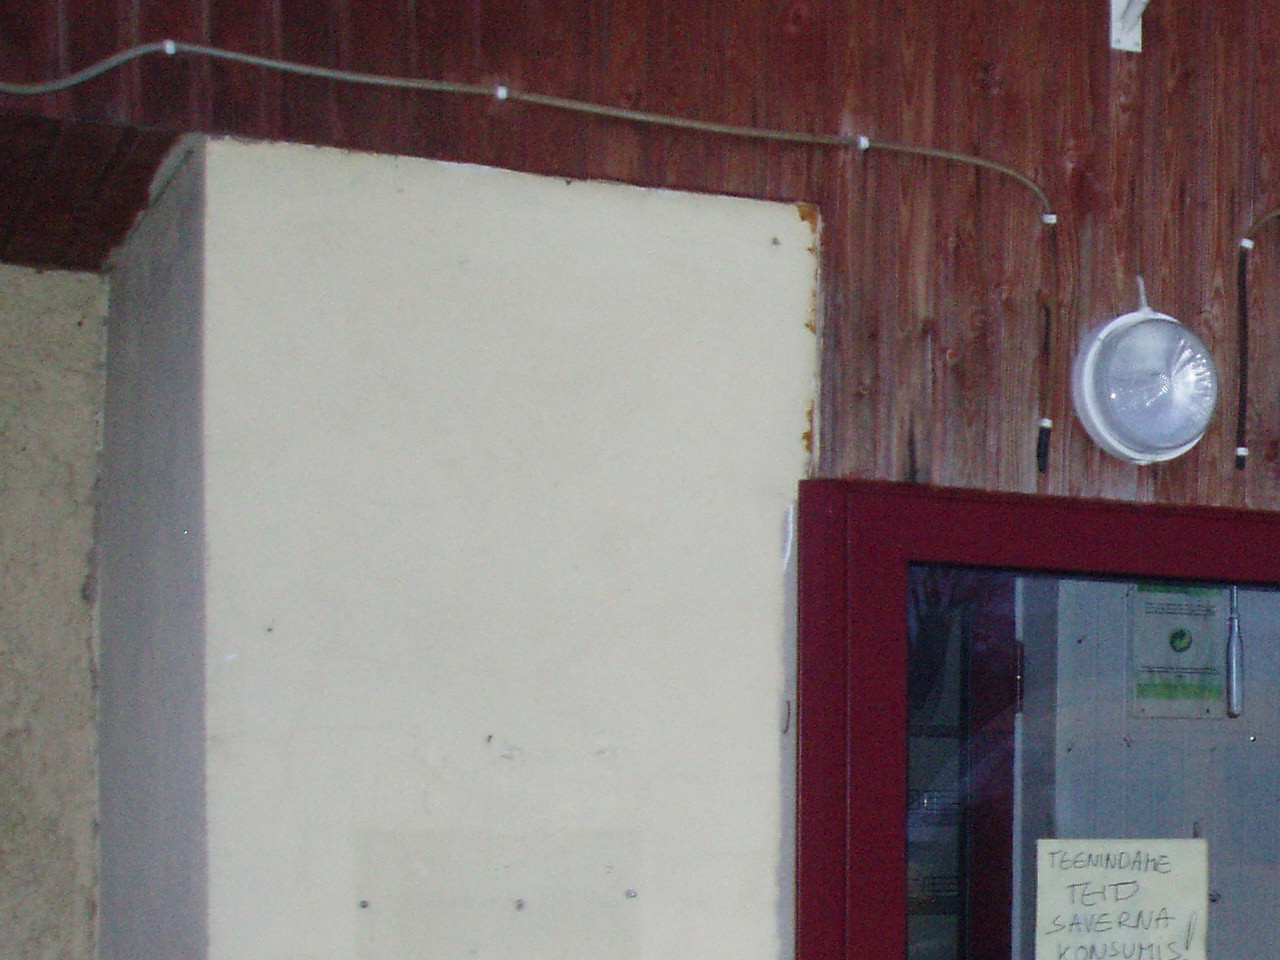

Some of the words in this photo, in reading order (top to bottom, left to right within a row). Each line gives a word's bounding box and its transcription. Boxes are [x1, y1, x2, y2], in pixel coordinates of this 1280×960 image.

[1048, 850, 1172, 874] TEENINDAME
[1066, 880, 1140, 907] TEID
[1045, 906, 1176, 935] SAVERNA
